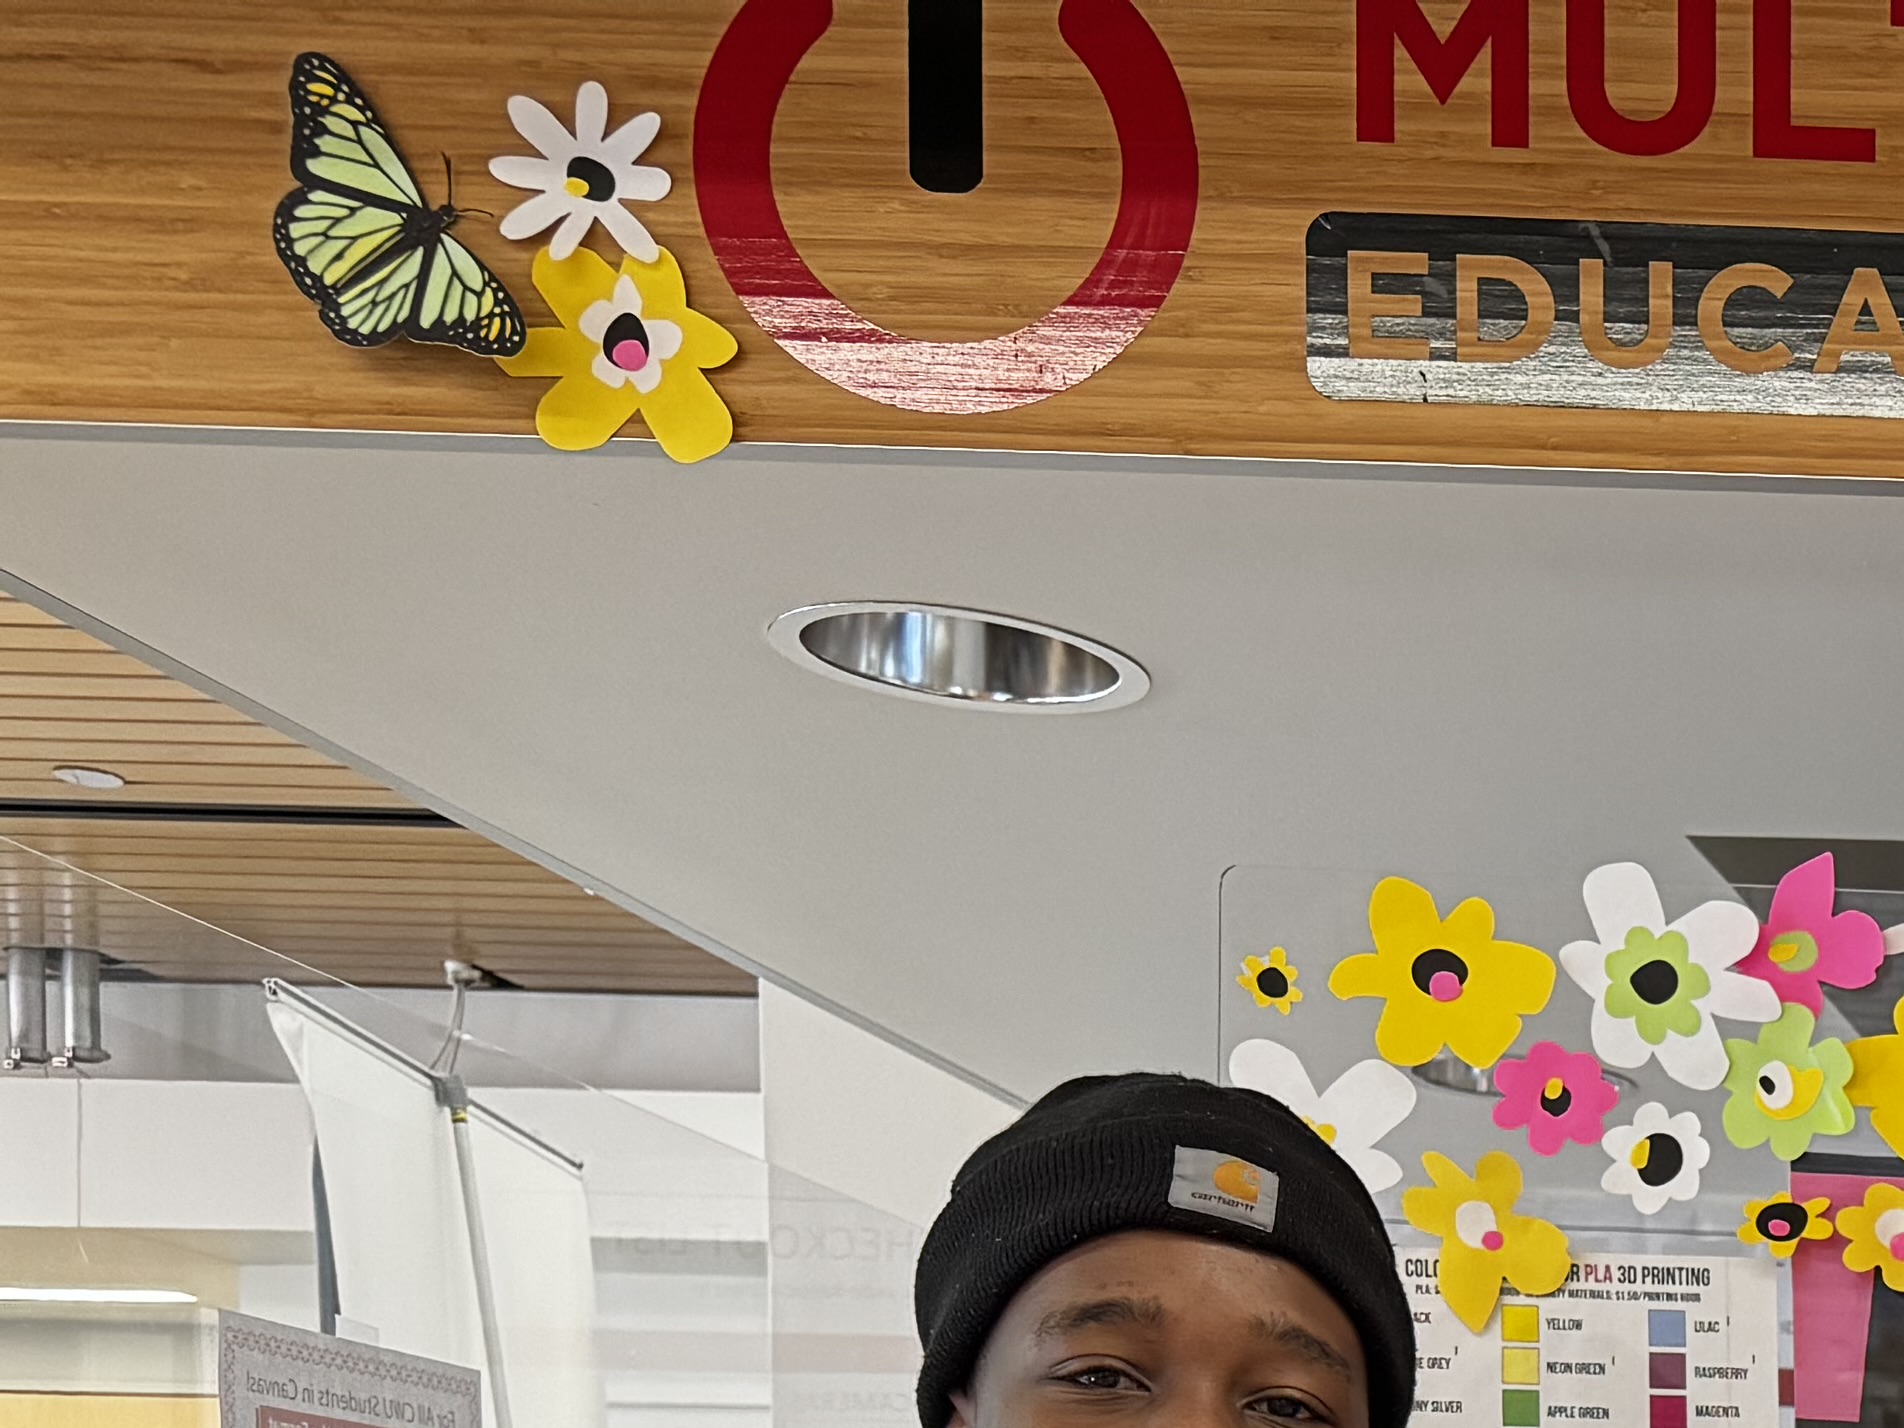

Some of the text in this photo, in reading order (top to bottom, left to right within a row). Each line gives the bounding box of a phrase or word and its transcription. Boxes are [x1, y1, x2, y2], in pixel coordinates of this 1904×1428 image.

[1191, 1192, 1255, 1212] carhartt
[1584, 1264, 1613, 1284] PLA
[1617, 1264, 1638, 1285] 3D
[1642, 1266, 1711, 1288] PRINTING
[1545, 1318, 1583, 1331] YELLOW
[1694, 1320, 1720, 1333] LILAC
[1427, 1357, 1452, 1370] GREY
[1546, 1362, 1606, 1376] NEON GREEN
[1694, 1366, 1748, 1380] RASPBERRY
[1431, 1400, 1463, 1413] SILVER
[1547, 1406, 1610, 1420] APPLE GREEN
[1695, 1404, 1740, 1418] MAGENTA
